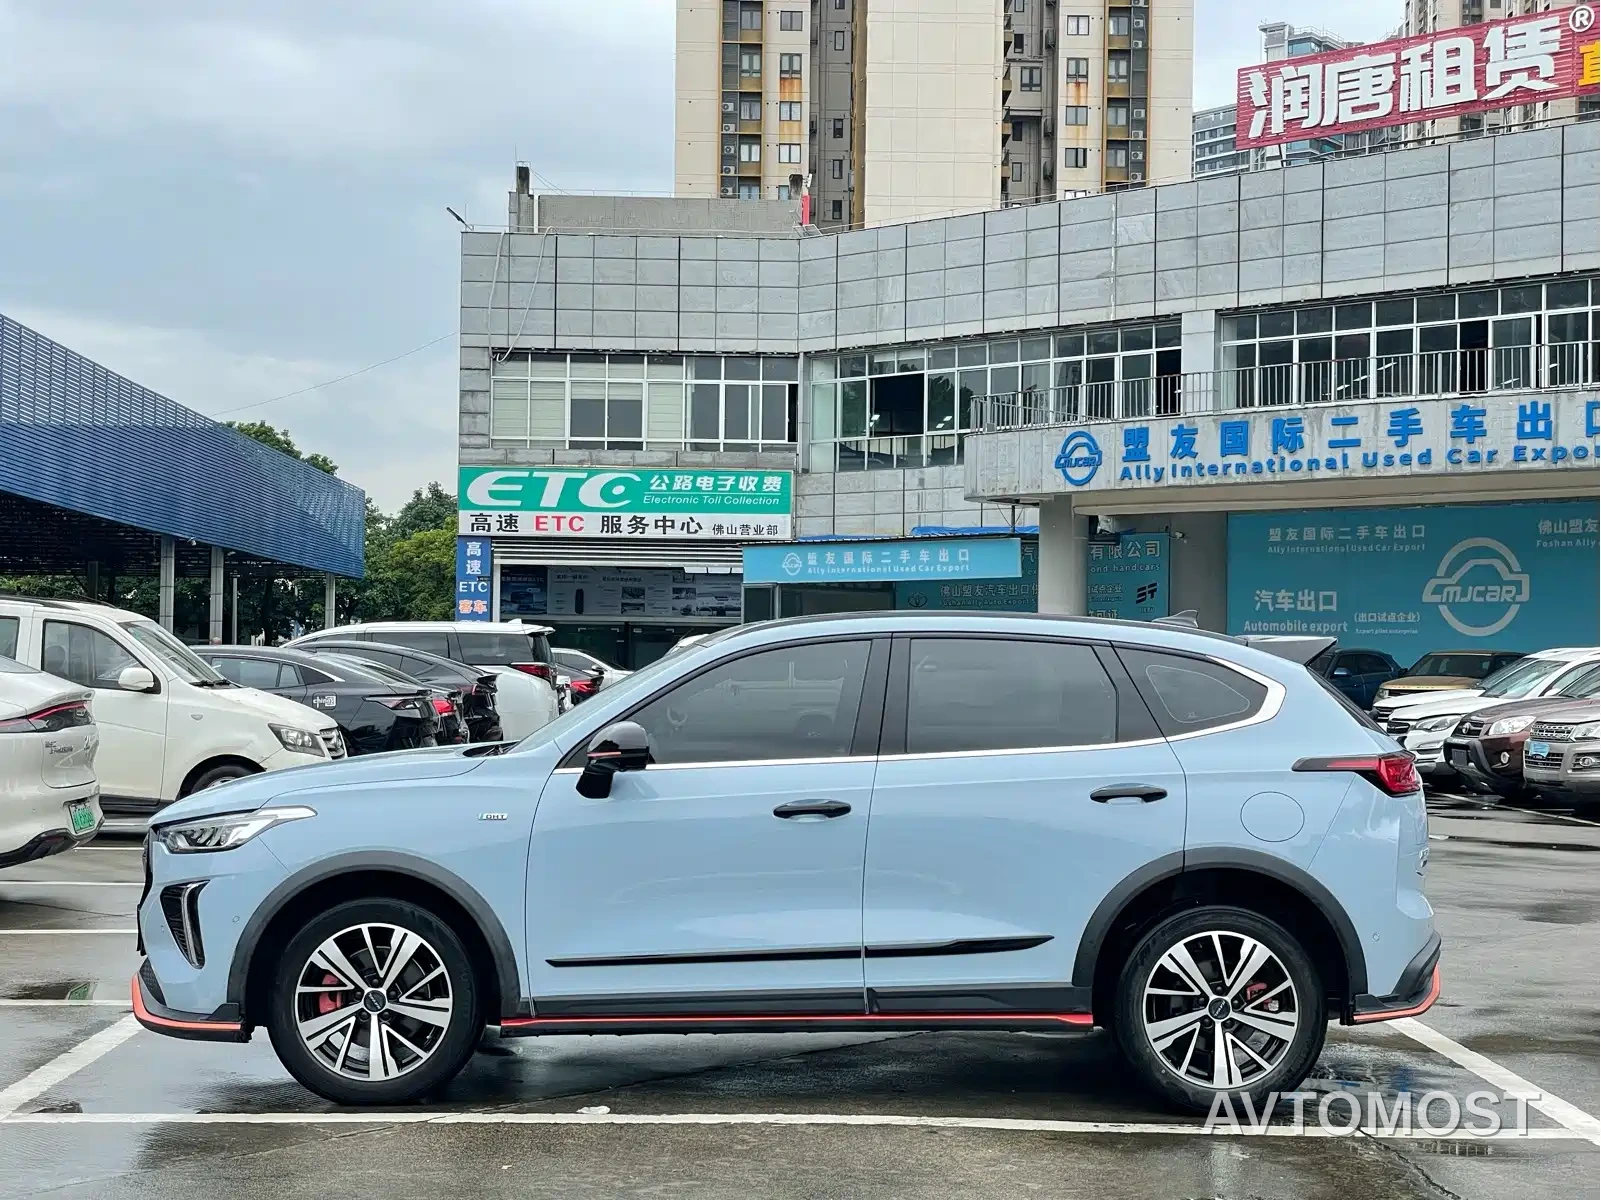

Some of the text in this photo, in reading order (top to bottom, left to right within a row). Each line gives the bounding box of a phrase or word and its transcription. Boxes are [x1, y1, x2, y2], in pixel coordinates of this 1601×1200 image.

[1248, 16, 1561, 138] 润唐租赁
[1120, 464, 1165, 483] Ally
[1171, 452, 1349, 478] International
[1362, 448, 1432, 468] Used
[1447, 448, 1498, 464] Car
[467, 470, 642, 508] ETC
[649, 475, 783, 492] 公路电子收费
[643, 495, 780, 506] Electronic Toll Collection
[470, 513, 779, 536] 高速 ETC 服务中心 佛山营业部
[1538, 518, 1600, 535] 佛山盟友
[1268, 525, 1425, 541] 盟友国际二手车出口
[1090, 540, 1160, 560] 有限公司
[1268, 542, 1425, 555] Ally International Used Car Export
[1536, 537, 1597, 548] Foshan Ally
[466, 541, 482, 574] 高速
[807, 549, 969, 565] 盟友国际二手车出口
[808, 563, 969, 575] Ally International Used Car Export
[1139, 563, 1160, 572] cars
[459, 581, 488, 592] ETC
[1088, 585, 1122, 594] 试点企业
[459, 600, 488, 614] 客车
[1254, 589, 1338, 612] 汽车出口
[1243, 620, 1348, 635] Automobile export
